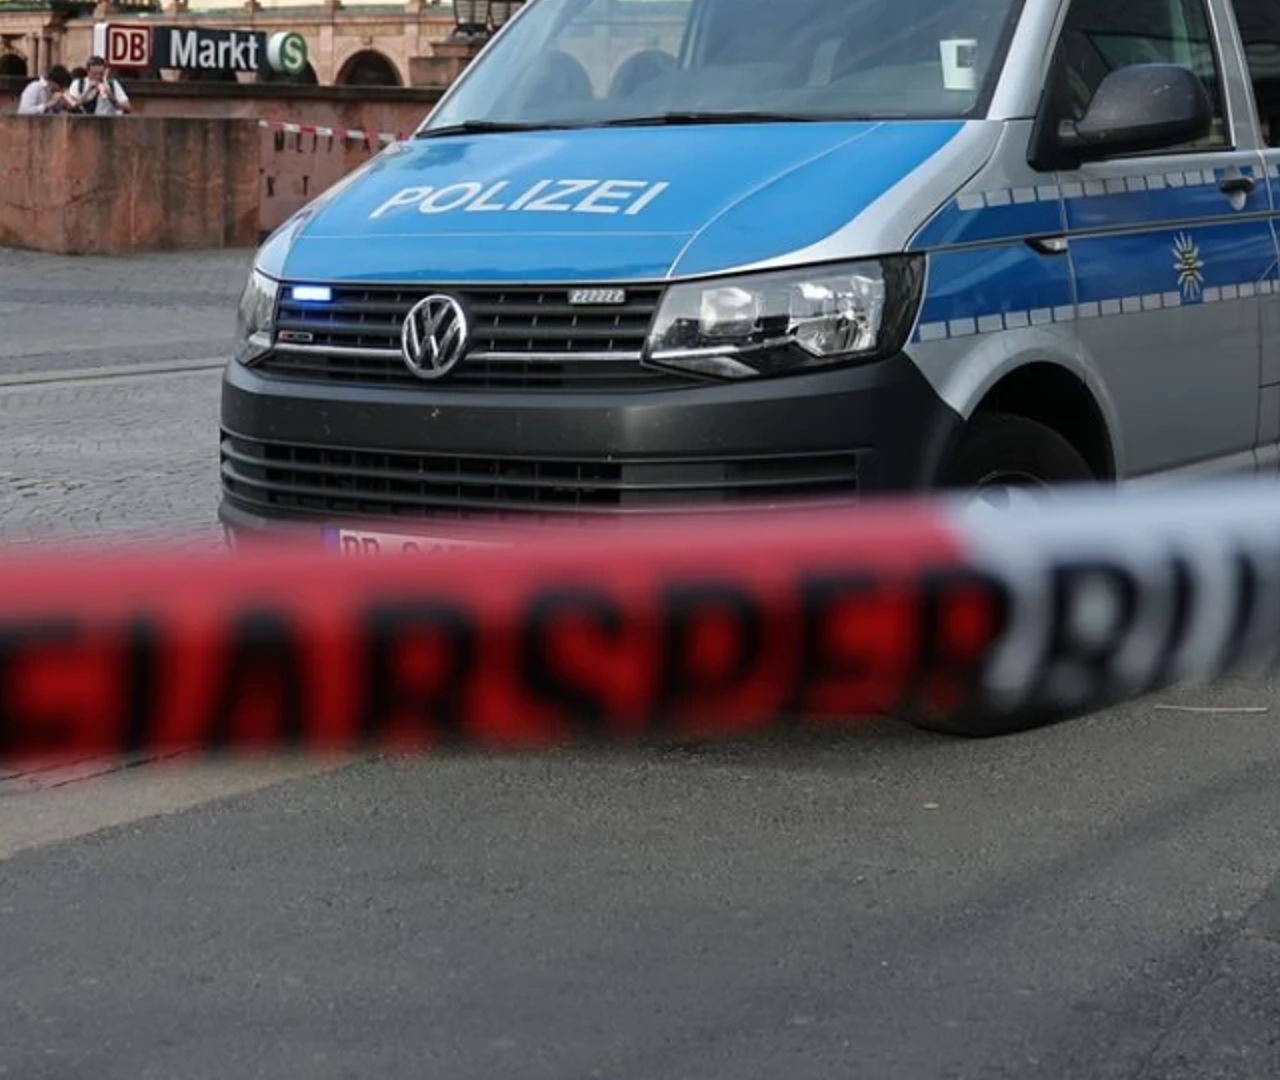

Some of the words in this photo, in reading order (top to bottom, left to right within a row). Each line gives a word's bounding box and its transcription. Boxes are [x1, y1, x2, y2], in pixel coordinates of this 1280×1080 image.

[111, 32, 146, 63] DB
[170, 29, 260, 69] Markt
[282, 37, 303, 69] S
[370, 178, 670, 219] POLIZEI
[402, 294, 468, 379] VW
